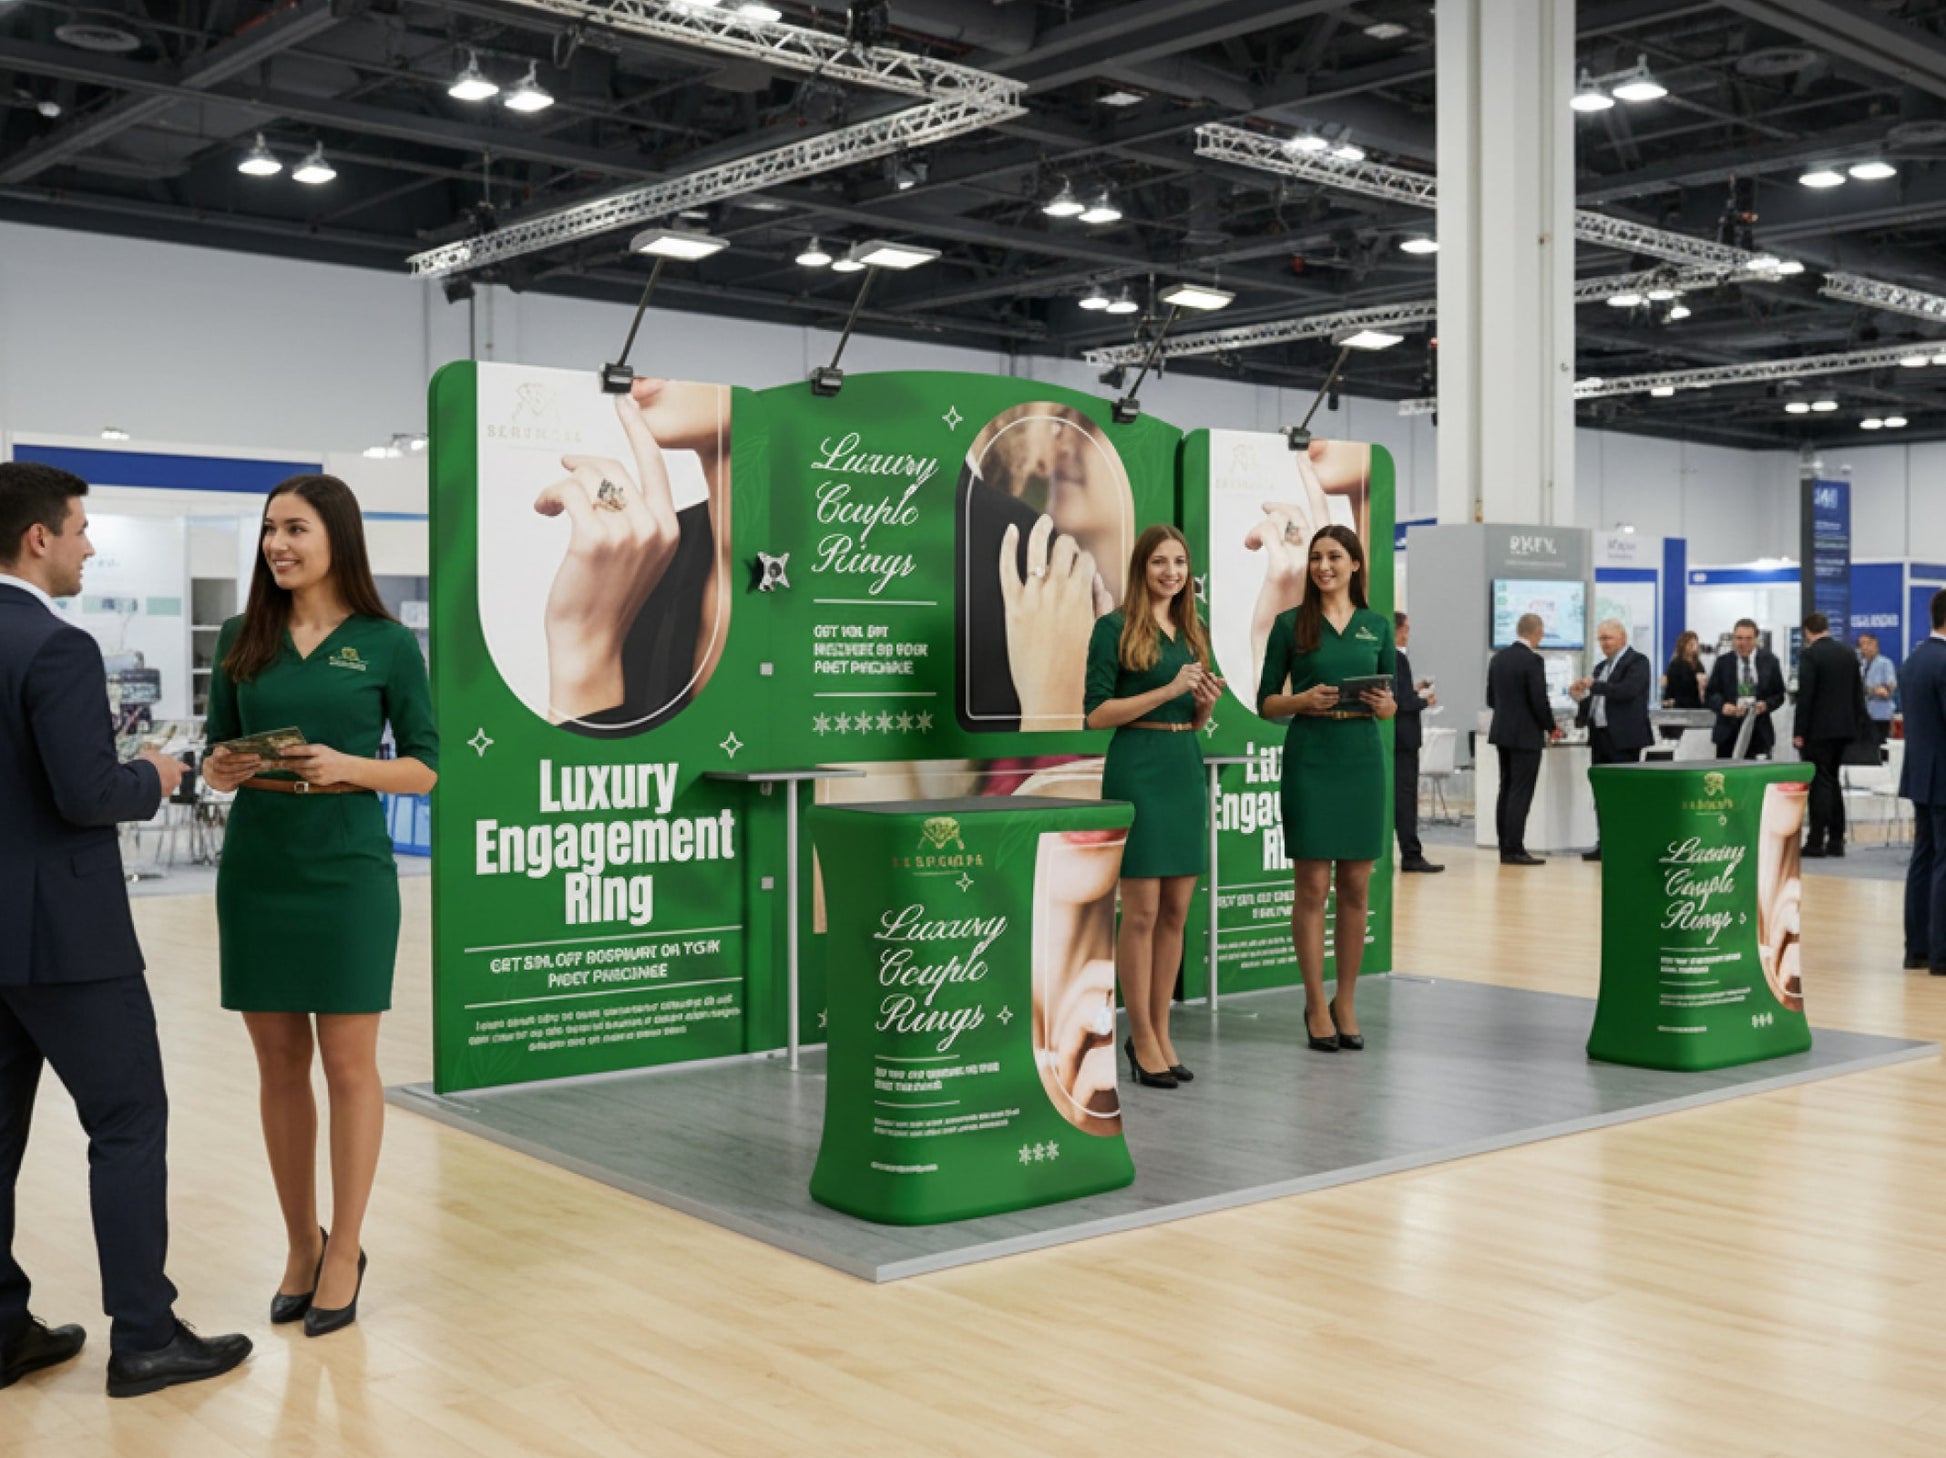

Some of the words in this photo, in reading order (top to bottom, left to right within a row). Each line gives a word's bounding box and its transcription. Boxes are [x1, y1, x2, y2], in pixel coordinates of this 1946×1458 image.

[811, 432, 939, 487] Luxury
[811, 533, 917, 595] Rings
[540, 758, 679, 814] Luxury
[476, 808, 735, 879] Engagement
[565, 871, 653, 927] Ring
[873, 903, 1009, 947] Luxury
[875, 992, 985, 1052] Rings
